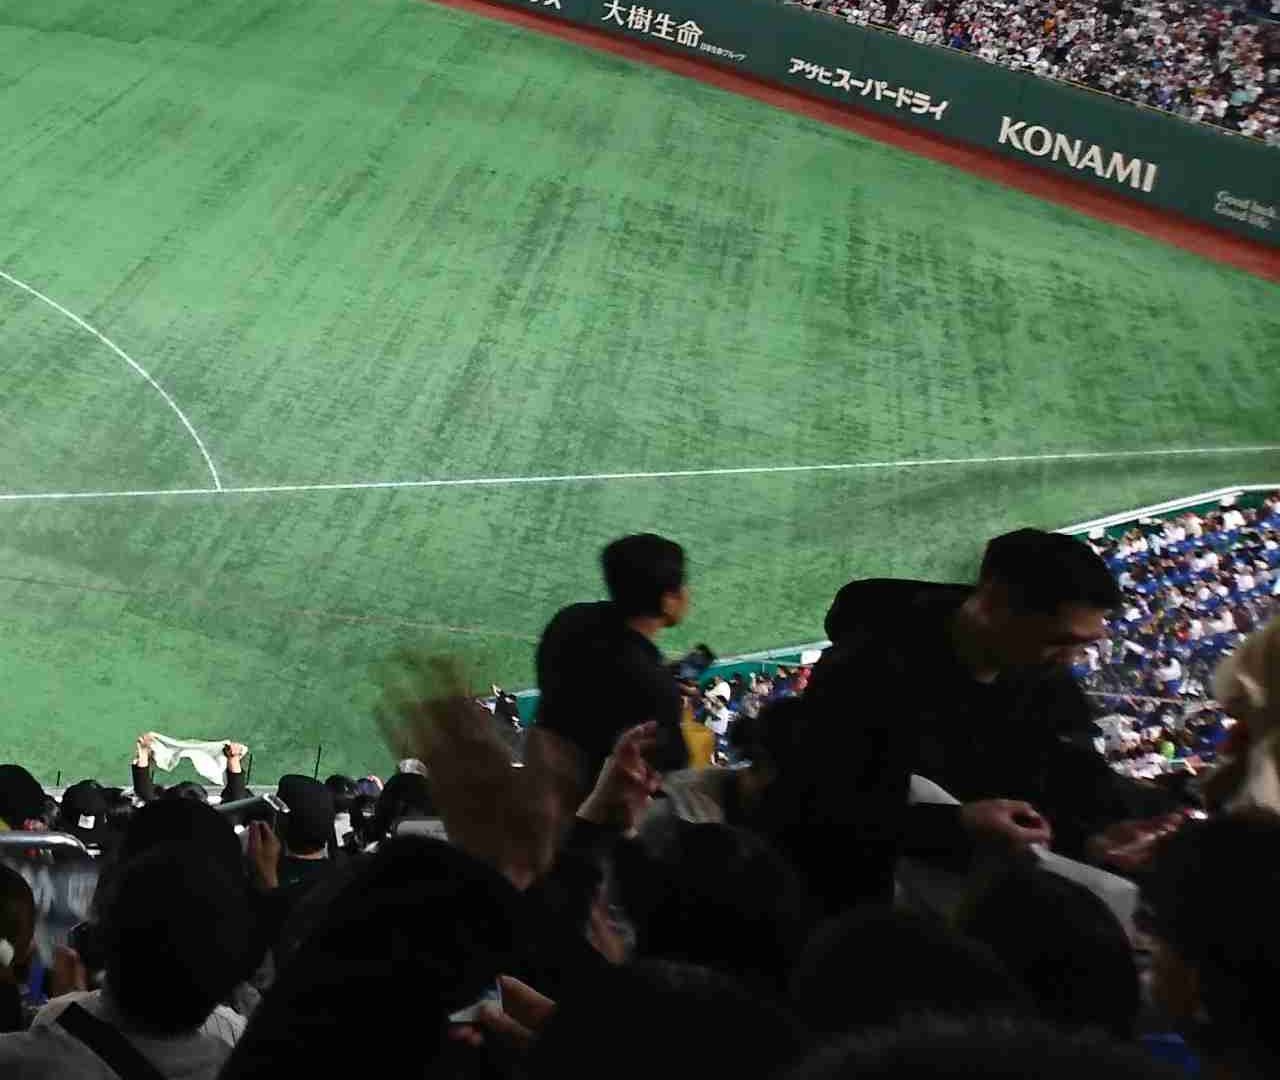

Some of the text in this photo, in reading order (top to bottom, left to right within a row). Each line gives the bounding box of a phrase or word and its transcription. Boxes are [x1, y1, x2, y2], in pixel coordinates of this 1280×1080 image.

[788, 56, 951, 122] アサヒスーパードライ
[997, 115, 1159, 193] KONAMI
